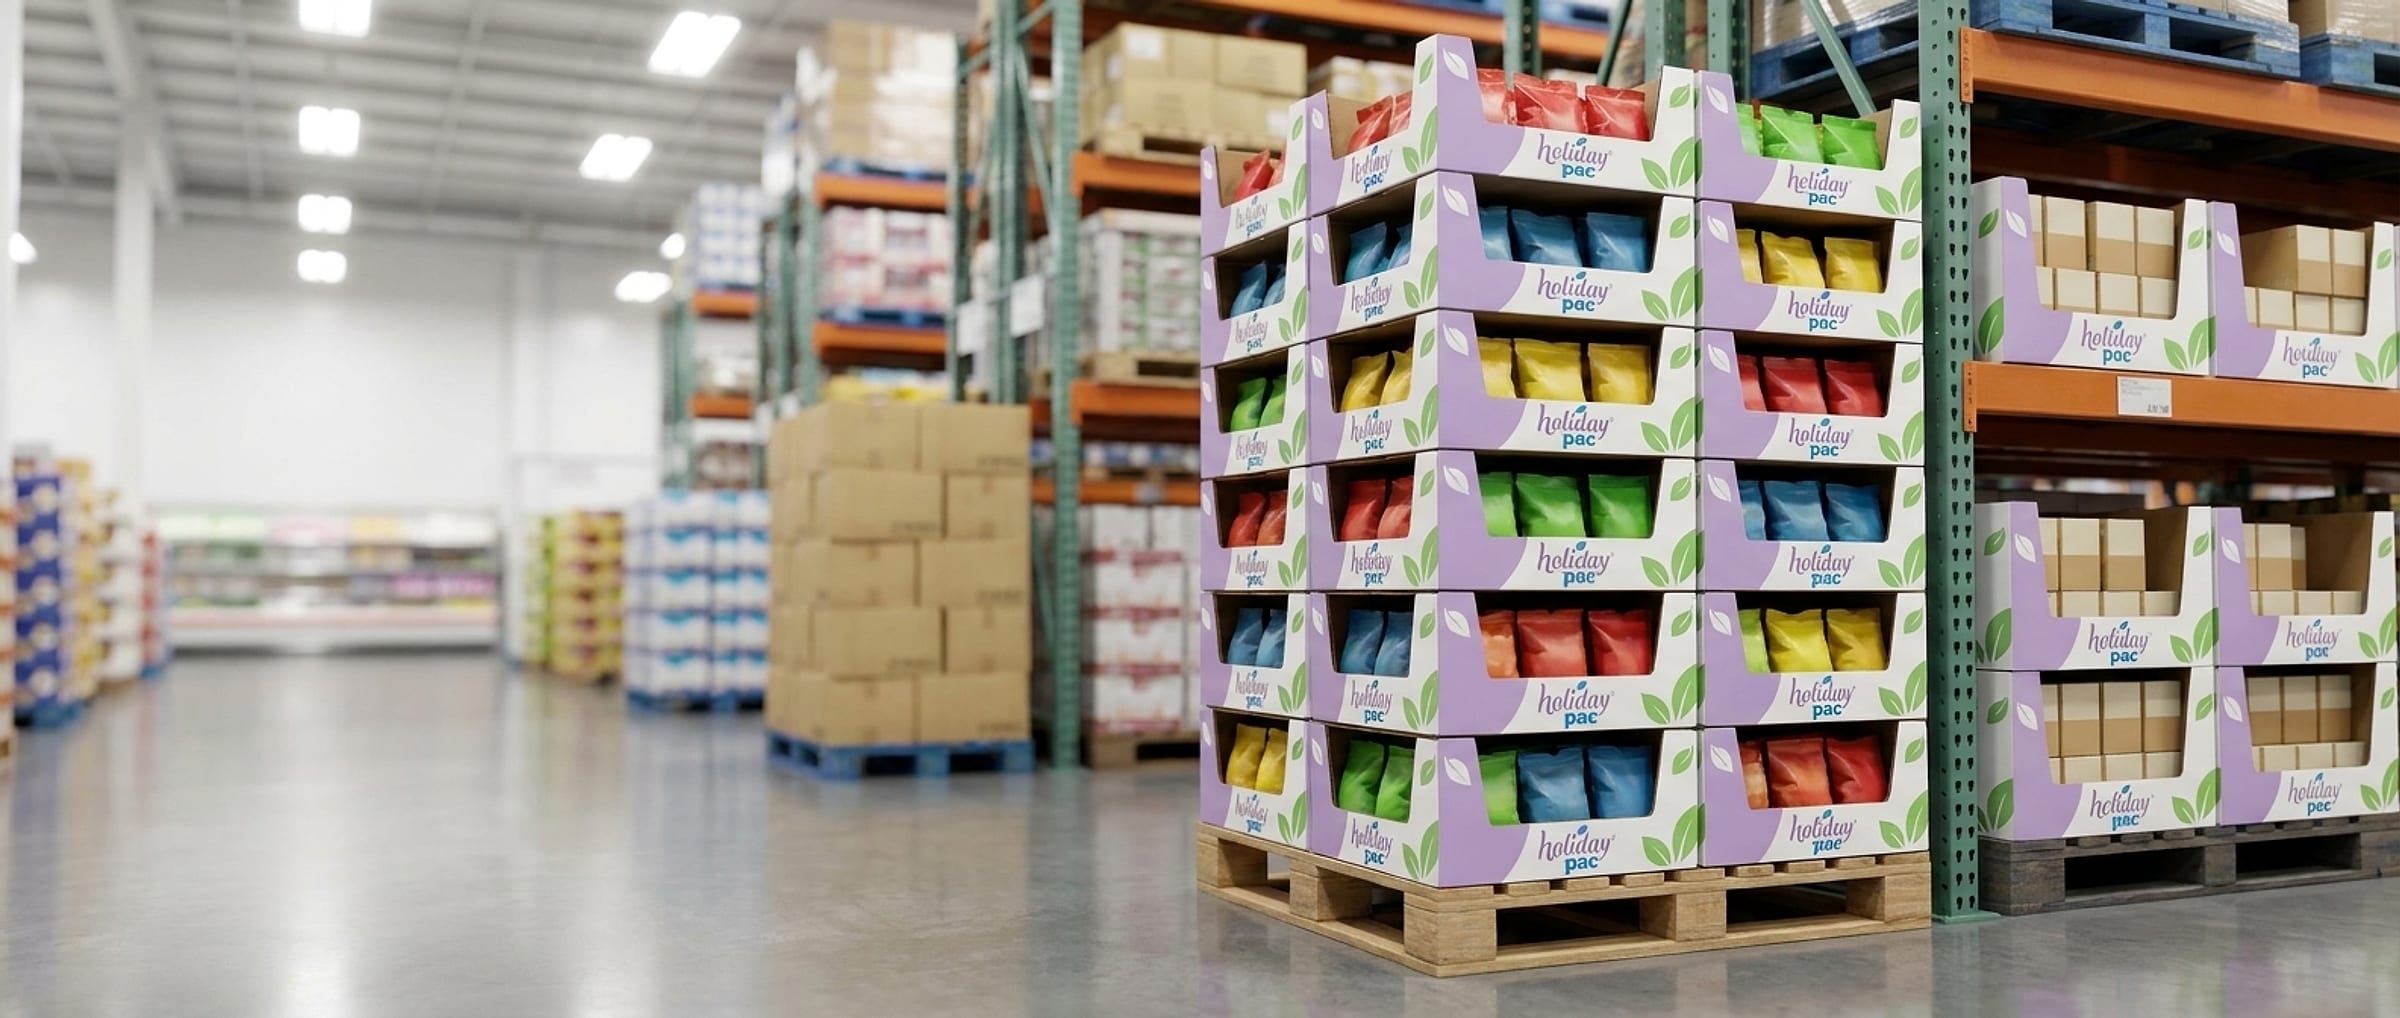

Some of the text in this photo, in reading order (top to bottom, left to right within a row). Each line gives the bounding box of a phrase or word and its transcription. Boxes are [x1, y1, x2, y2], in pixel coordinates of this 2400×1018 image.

[1808, 192, 1837, 206] pac
[1537, 268, 1608, 304] holiday
[1562, 298, 1595, 313] pac
[2302, 364, 2327, 378] pac
[1537, 403, 1609, 440] holiday
[1563, 433, 1596, 449] pac
[1789, 417, 1850, 449] holiday
[1810, 445, 1839, 459] pac
[2110, 650, 2138, 665] pac
[1538, 683, 1610, 716] holiday
[1564, 711, 1598, 729] pac
[1812, 703, 1842, 720] pac
[1538, 830, 1610, 861] holiday
[1565, 856, 1598, 874] pac
